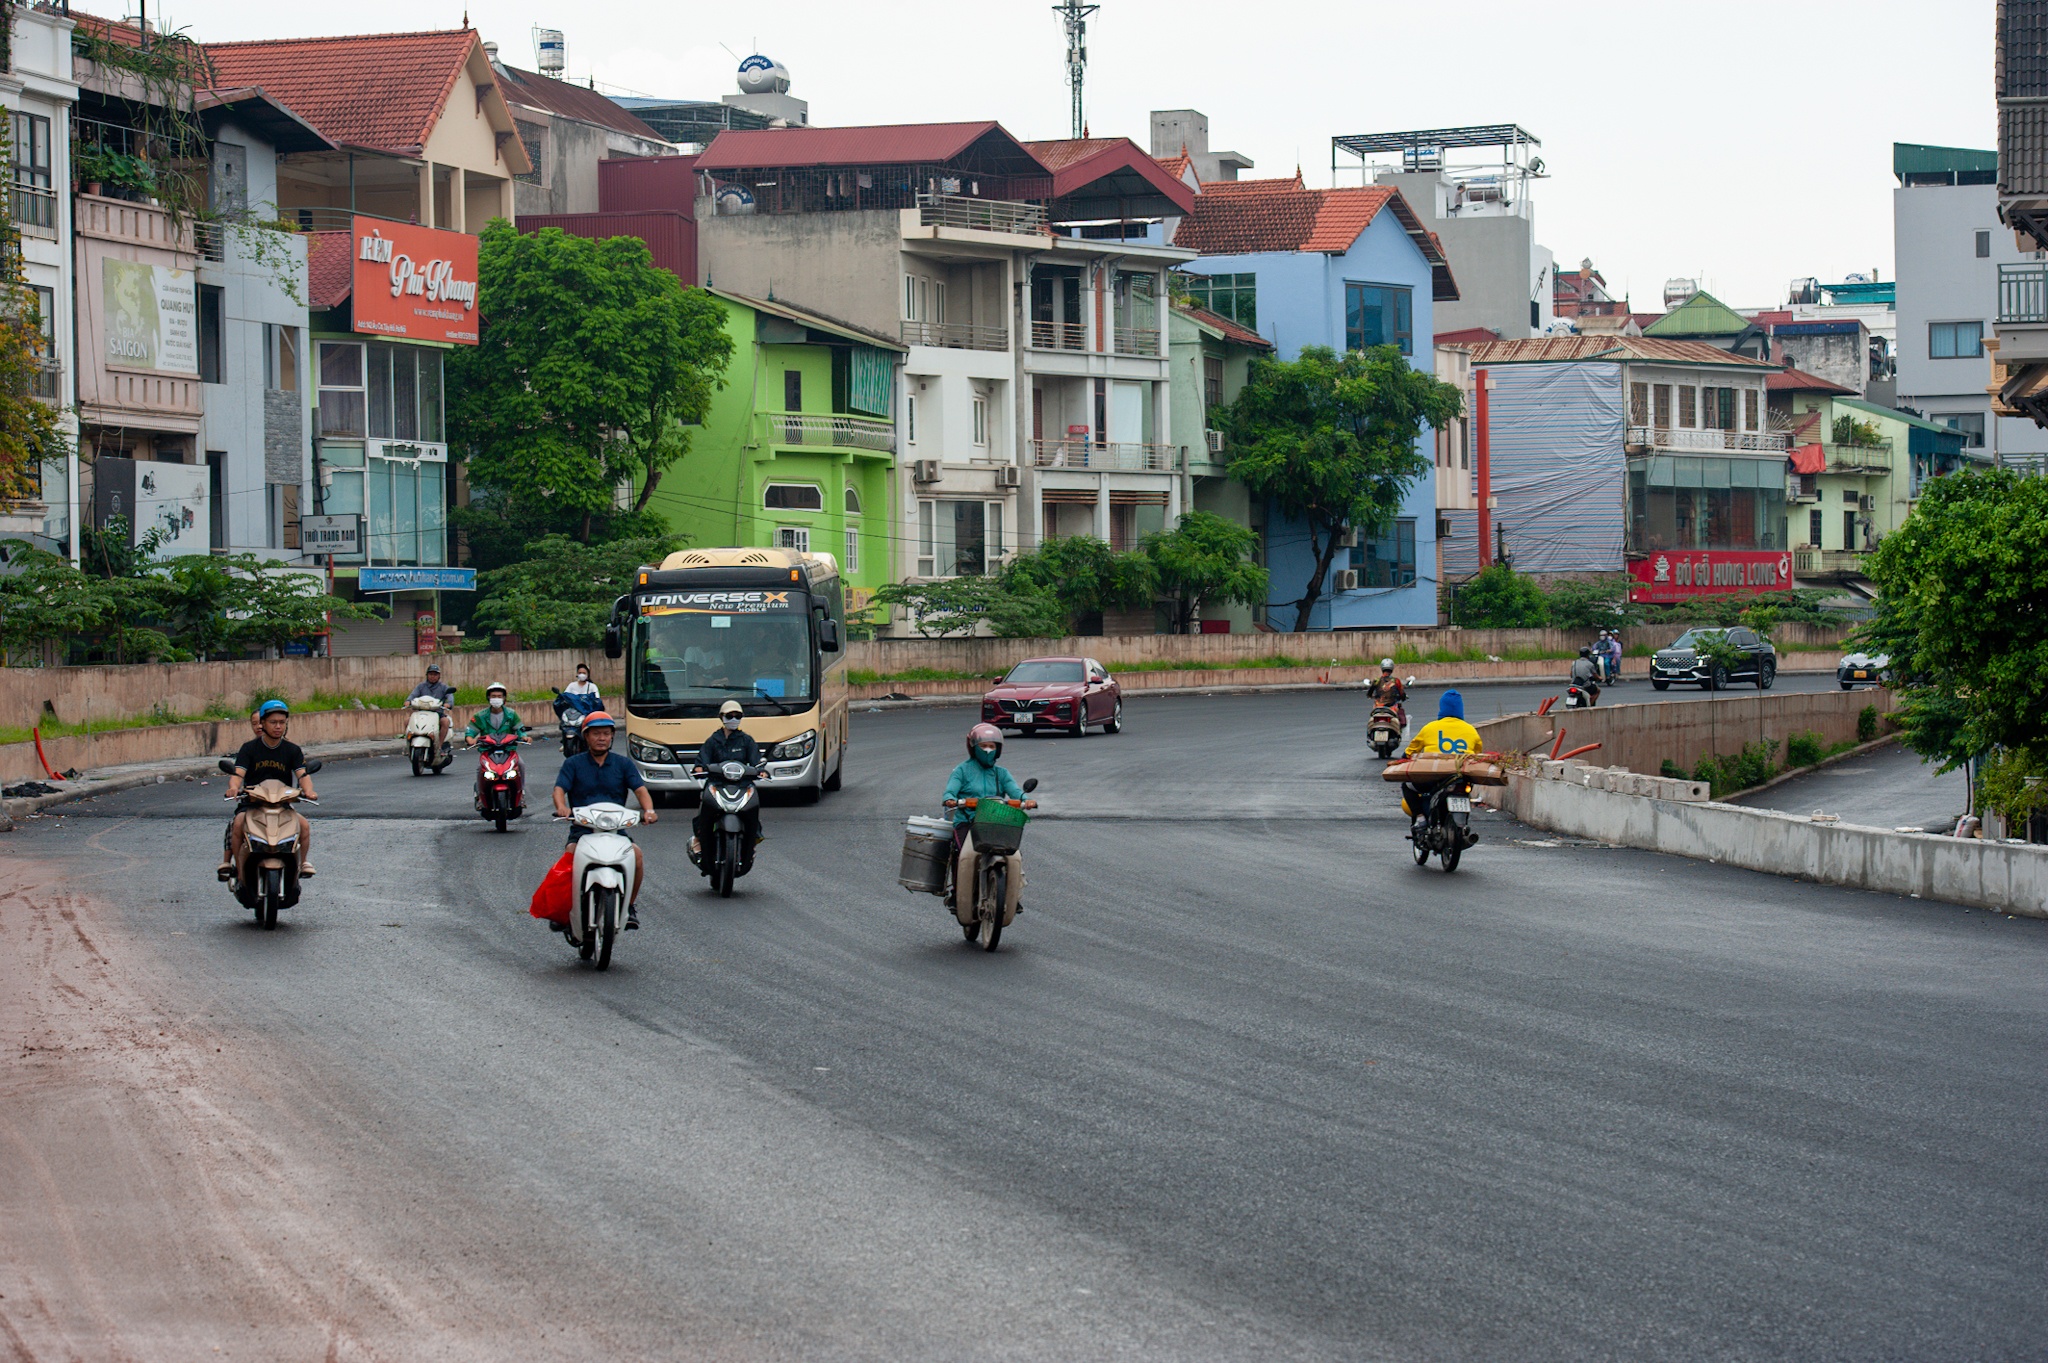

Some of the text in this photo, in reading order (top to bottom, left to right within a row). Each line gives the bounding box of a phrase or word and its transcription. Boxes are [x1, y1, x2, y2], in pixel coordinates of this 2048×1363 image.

[742, 58, 768, 69] SONHA
[359, 228, 394, 264] RÈM
[389, 254, 477, 311] Phú Khang
[161, 299, 195, 314] QUANG HUY
[123, 327, 135, 338] BIA
[110, 337, 148, 360] SAIGON
[319, 530, 340, 542] TRANG
[341, 529, 355, 541] NAM
[1694, 553, 1711, 586] GỖ
[1747, 562, 1777, 586] LONG
[709, 601, 789, 611] New Premium
[1439, 730, 1468, 754] be
[255, 759, 286, 772] JORDAN
